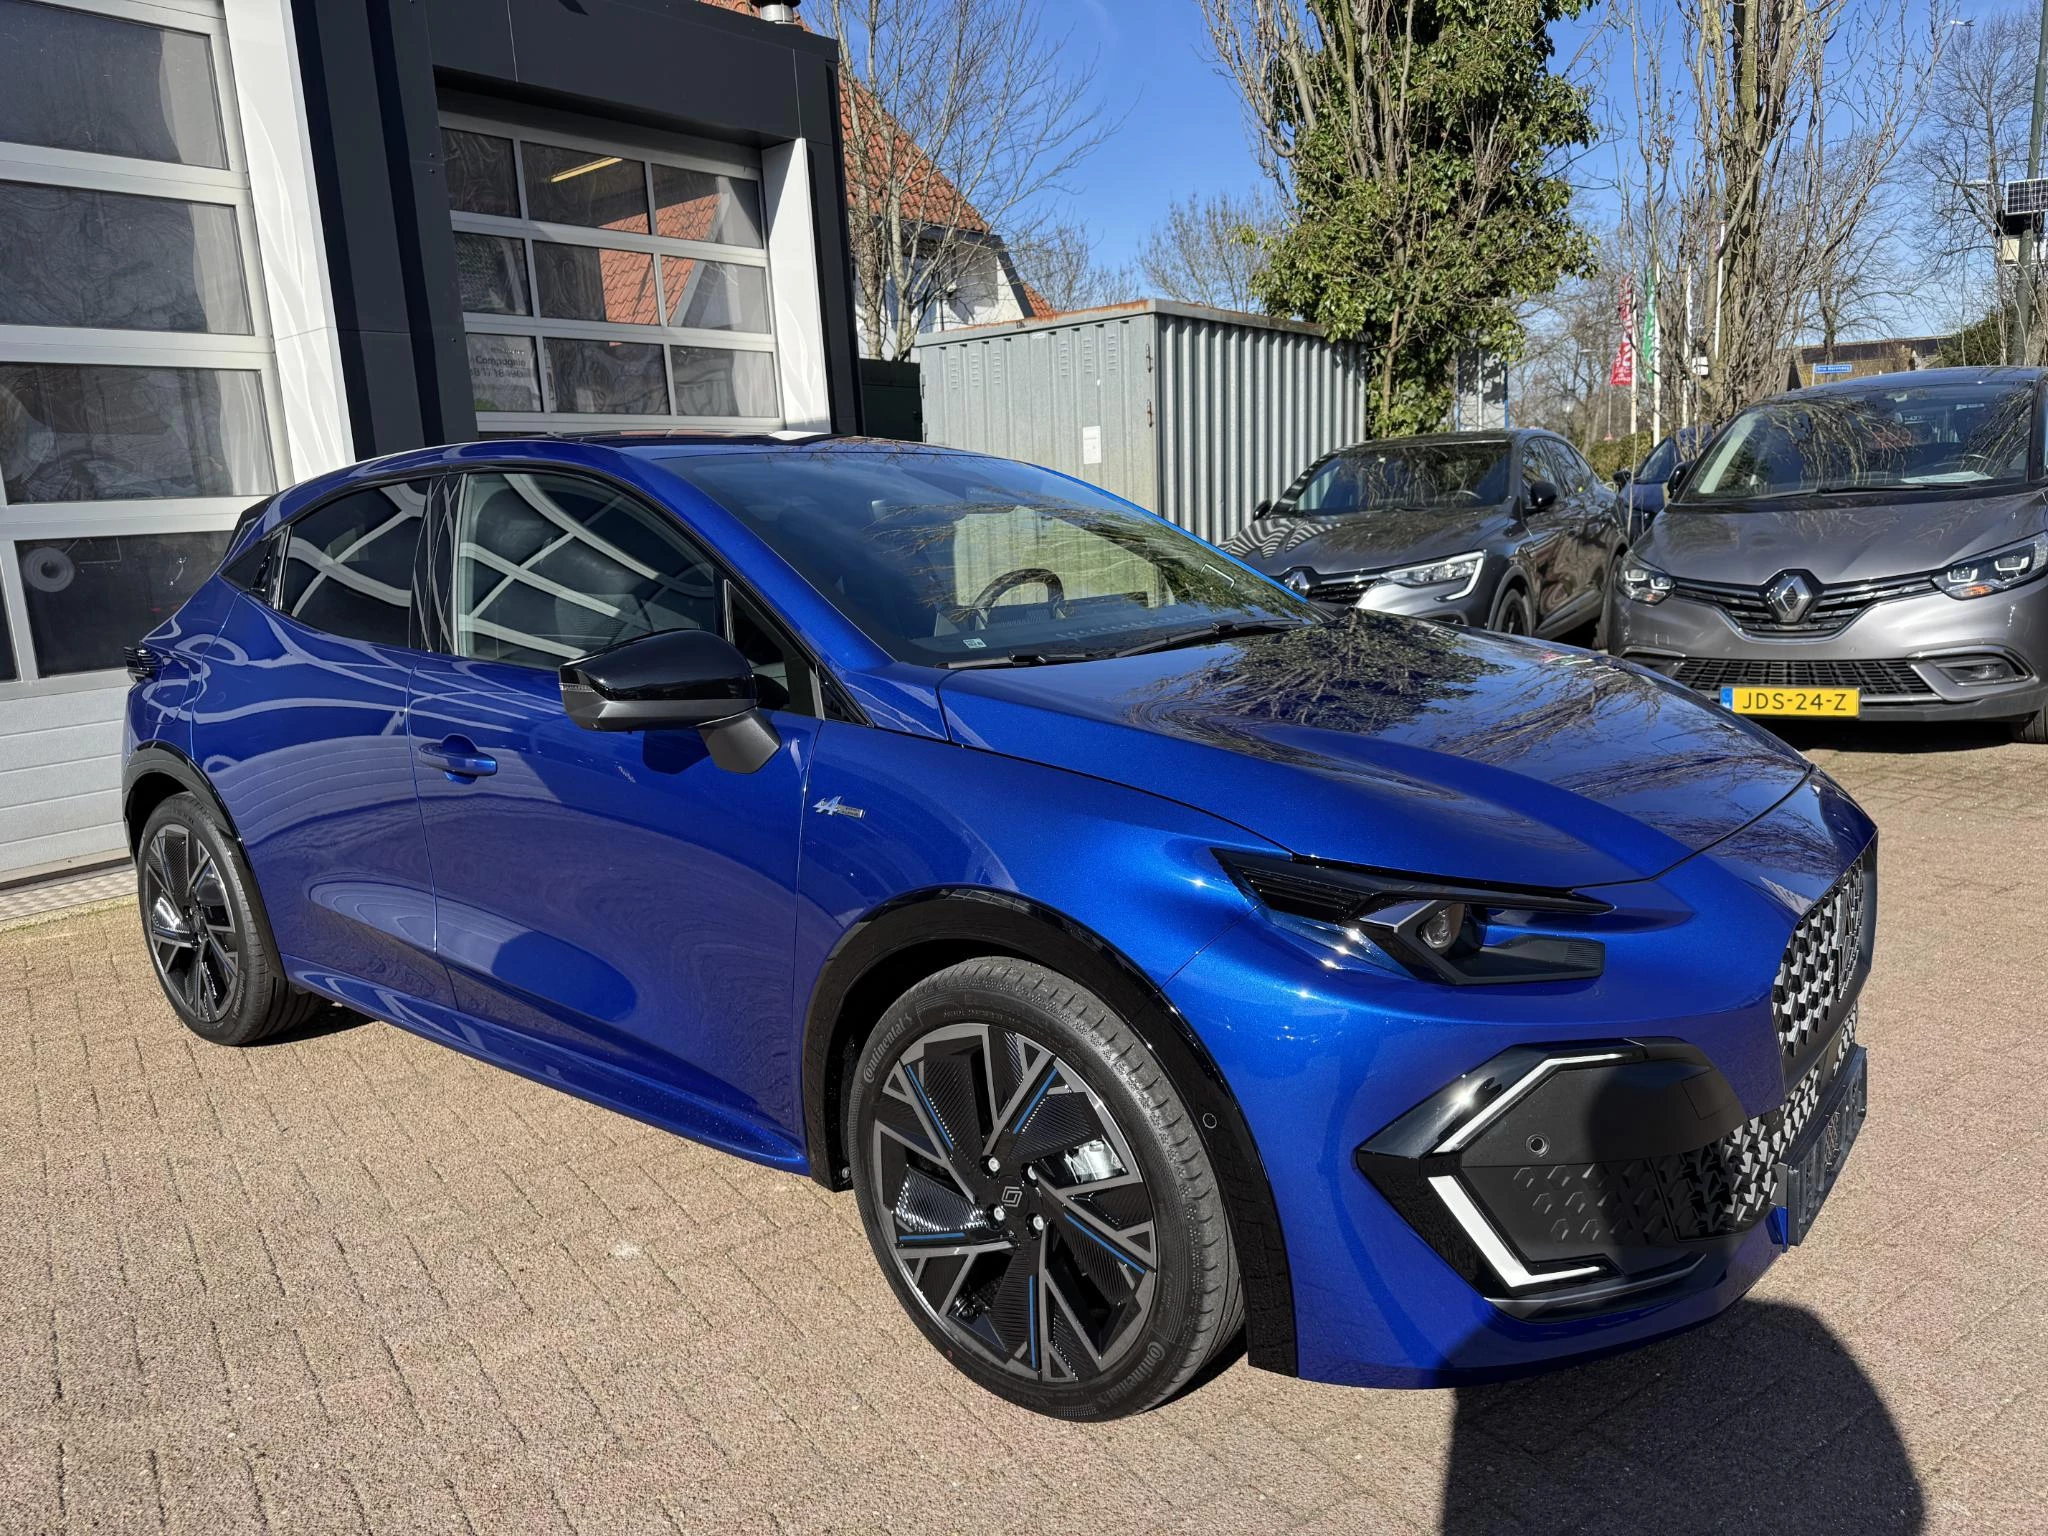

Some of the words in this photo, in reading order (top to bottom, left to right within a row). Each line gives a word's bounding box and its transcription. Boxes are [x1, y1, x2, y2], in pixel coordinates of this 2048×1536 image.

[1742, 692, 1847, 711] JDS-24-Z
[863, 1017, 907, 1084] Continental
[1106, 1341, 1166, 1404] Continental
